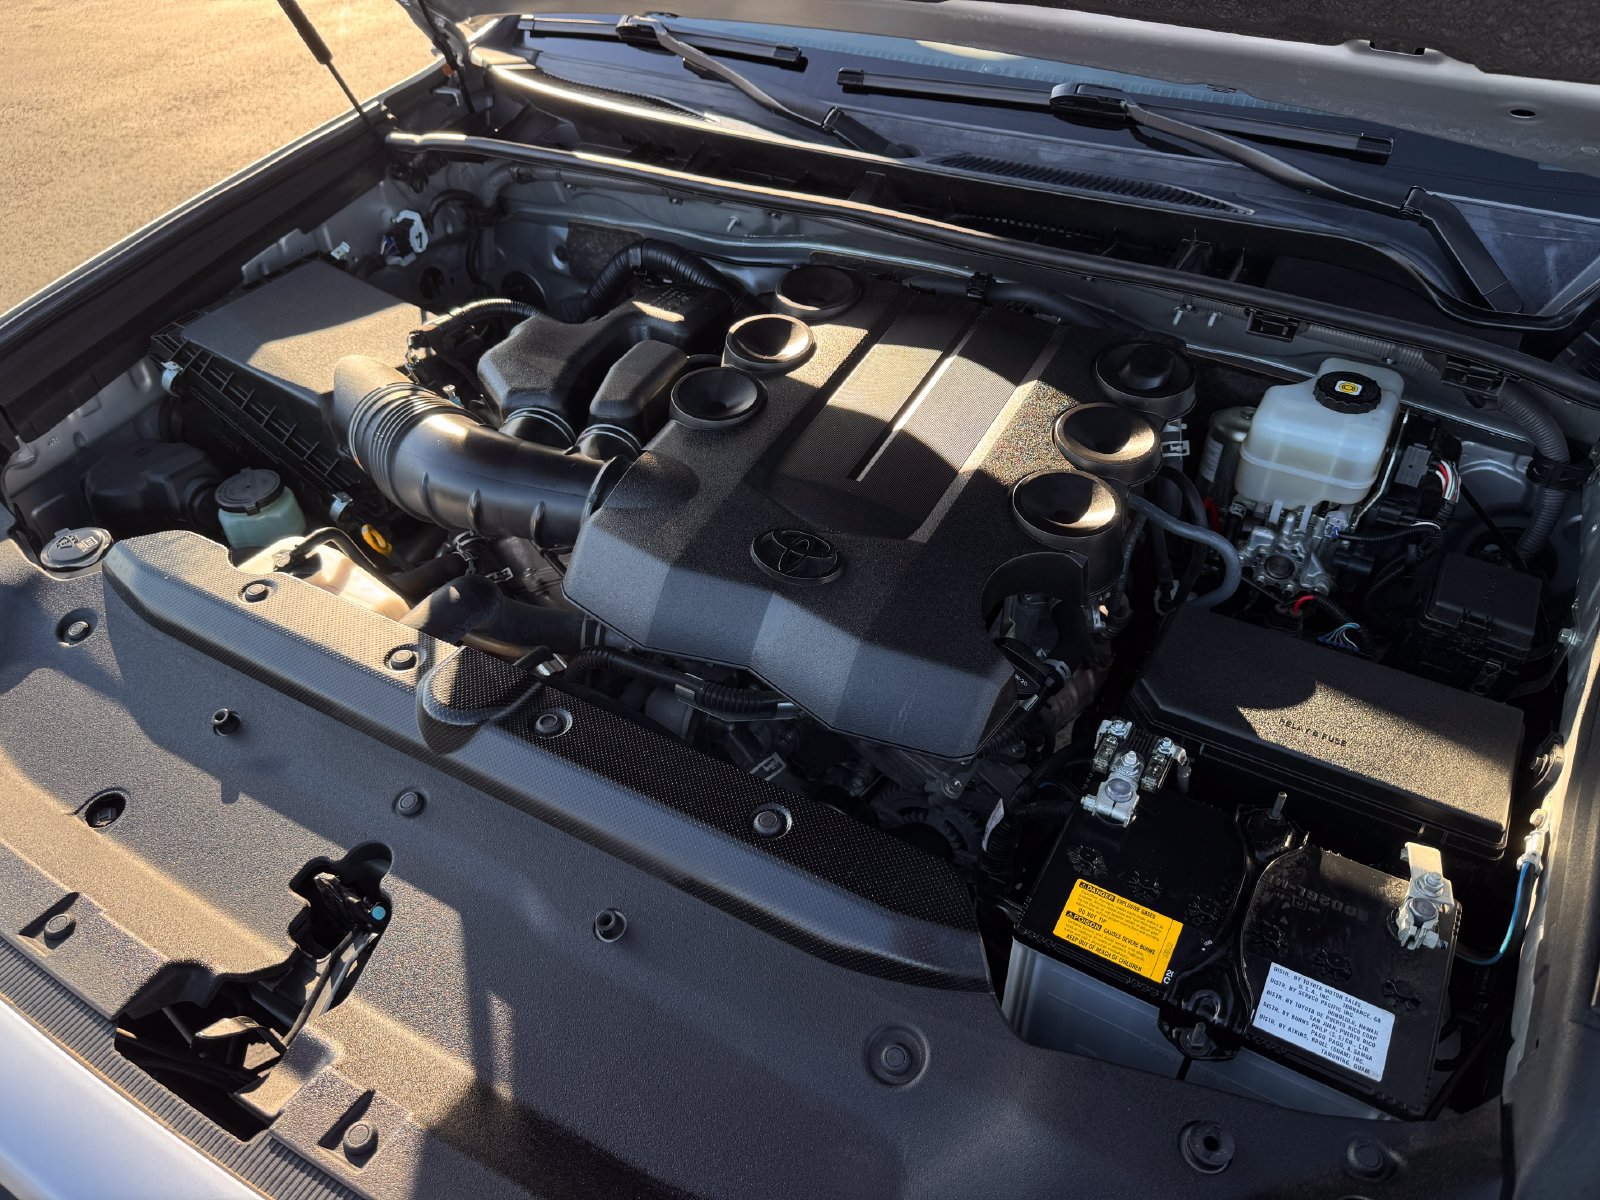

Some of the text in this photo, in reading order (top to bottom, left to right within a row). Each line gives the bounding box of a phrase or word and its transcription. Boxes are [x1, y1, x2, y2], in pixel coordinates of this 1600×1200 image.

[1278, 717, 1310, 734] RELAY
[1321, 733, 1347, 747] FUSE
[1086, 885, 1156, 919] DANGER EXPLOSIVE GASES
[1086, 911, 1096, 919] NOT
[1098, 916, 1107, 924] TIP
[1072, 913, 1101, 930] POISON
[1103, 927, 1121, 939] CAUSES
[1121, 935, 1138, 947] SEVERE
[1139, 943, 1155, 955] BURNS
[1066, 933, 1078, 942] KEEP
[1078, 938, 1088, 947] OUT
[1095, 946, 1111, 958] REACH
[1110, 953, 1118, 961] OF
[1118, 957, 1142, 972] CHILDREN
[1288, 985, 1296, 993] BY
[1297, 989, 1318, 1002] SERVCO
[1320, 999, 1341, 1012] PACIFIC
[1293, 974, 1301, 982] BY
[1302, 978, 1322, 991] TOYOTA
[1324, 988, 1343, 1000] MOTOR
[1281, 1009, 1289, 1017] BY
[1290, 1013, 1309, 1026] BURNS
[1311, 1022, 1327, 1034] PHILP
[1285, 997, 1292, 1005] BY
[1294, 1001, 1315, 1014] TOYOTA
[1325, 1015, 1346, 1028] PUERTO
[1347, 1024, 1361, 1035] RICO
[1308, 1014, 1320, 1024] SAN
[1339, 1028, 1360, 1041] PUERTO
[1362, 1038, 1375, 1048] RICO
[1358, 1023, 1378, 1036] HAWAII
[1278, 1022, 1286, 1030] BY
[1311, 1036, 1328, 1048] KROLL
[1330, 1045, 1351, 1059] (GUAM)
[1310, 1029, 1326, 1040] PAGO
[1353, 1048, 1372, 1061] SAMOA
[1353, 1062, 1370, 1074] GUAM
